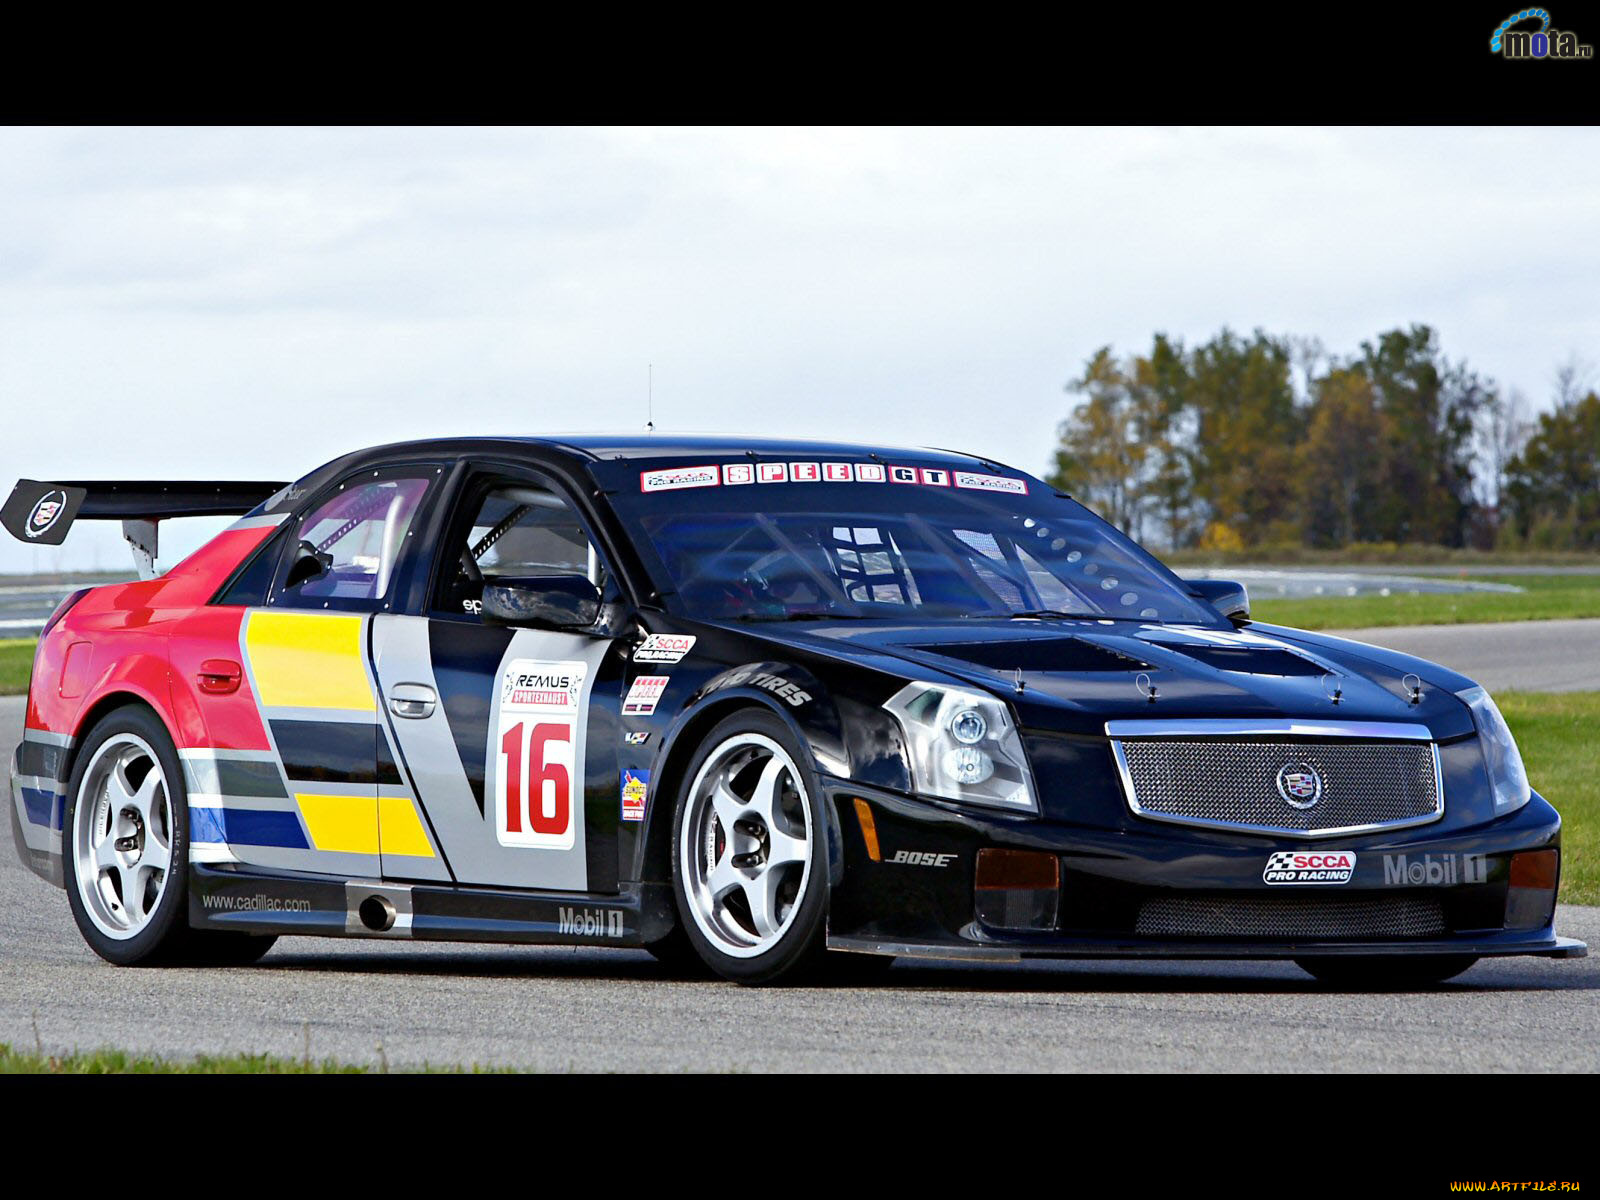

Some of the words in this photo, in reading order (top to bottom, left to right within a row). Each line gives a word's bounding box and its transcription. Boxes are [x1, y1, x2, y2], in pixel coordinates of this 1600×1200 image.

[728, 464, 882, 483] SPEED
[894, 469, 943, 484] GT
[656, 639, 689, 650] SCCA
[515, 674, 570, 688] REMUS
[749, 672, 813, 706] TIRES
[512, 691, 567, 705] SPORTEXHAUST
[502, 721, 570, 834] 16
[884, 850, 958, 867] BOSE
[1293, 855, 1351, 868] SCCA
[1267, 870, 1296, 881] PRO
[1297, 870, 1350, 881] RACING
[1383, 854, 1457, 885] Mobil
[202, 894, 311, 912] www.cadillac.com
[558, 906, 604, 937] Mobil
